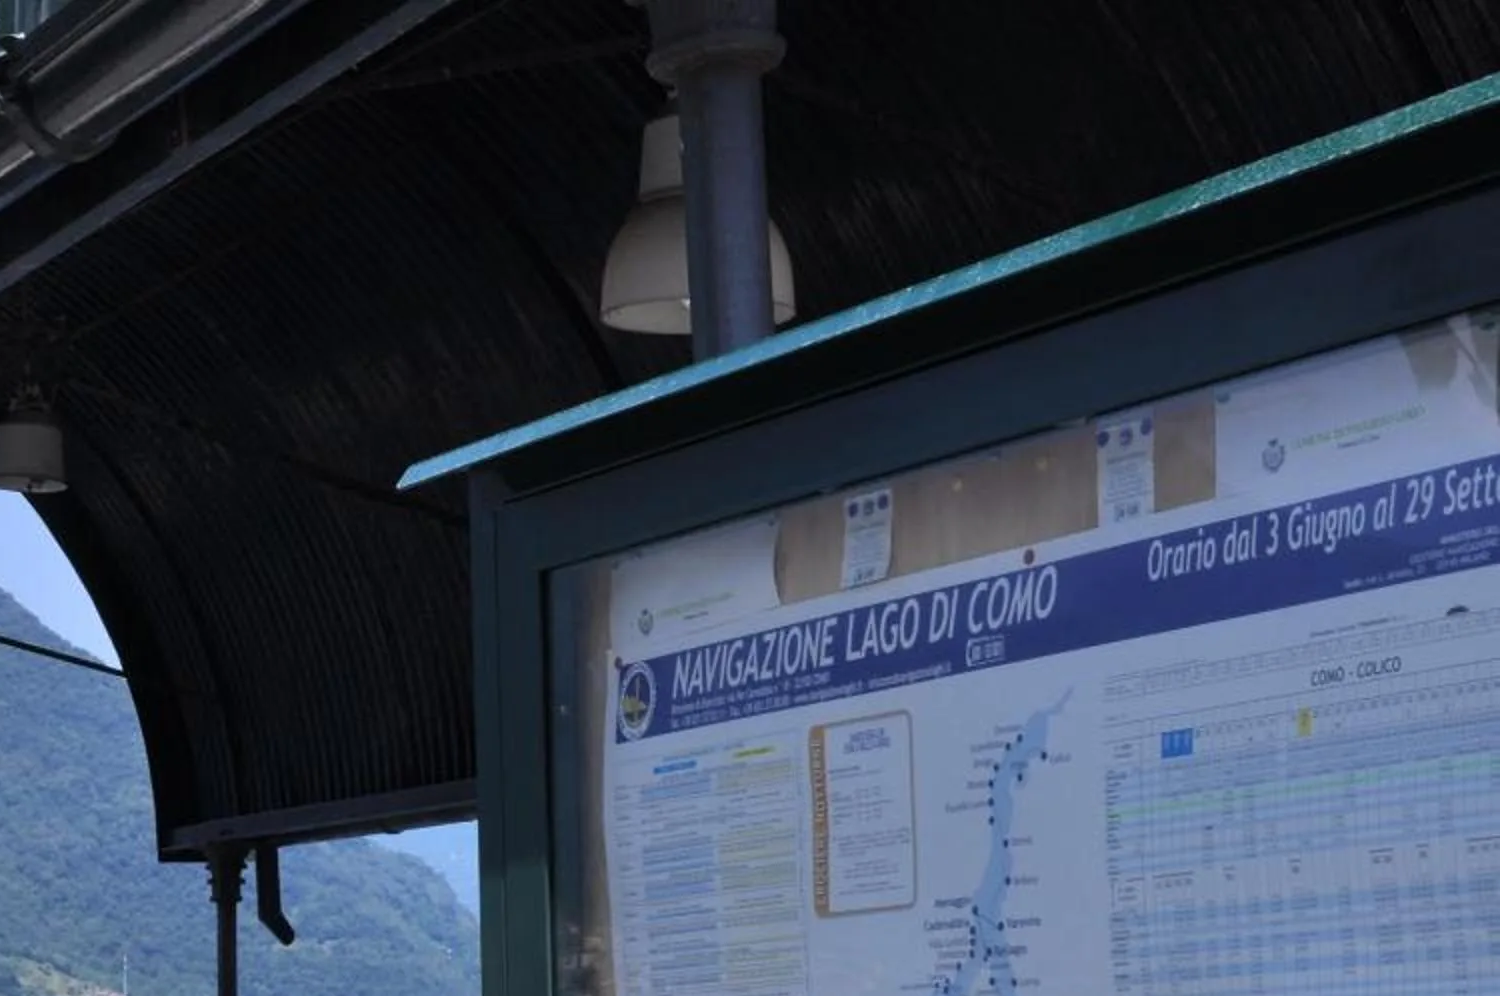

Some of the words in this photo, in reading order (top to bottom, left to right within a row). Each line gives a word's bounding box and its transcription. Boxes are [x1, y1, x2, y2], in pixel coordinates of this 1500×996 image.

[1147, 527, 1217, 581] Orario
[1223, 520, 1258, 565] dal
[1265, 511, 1280, 556] 3
[1287, 502, 1366, 554] Giugno
[1373, 482, 1397, 531] al
[1403, 475, 1436, 524] 29
[672, 616, 838, 699] NAVIGAZIONE
[845, 598, 921, 661] LAGO
[928, 587, 960, 643] DI
[967, 565, 1059, 634] COMO
